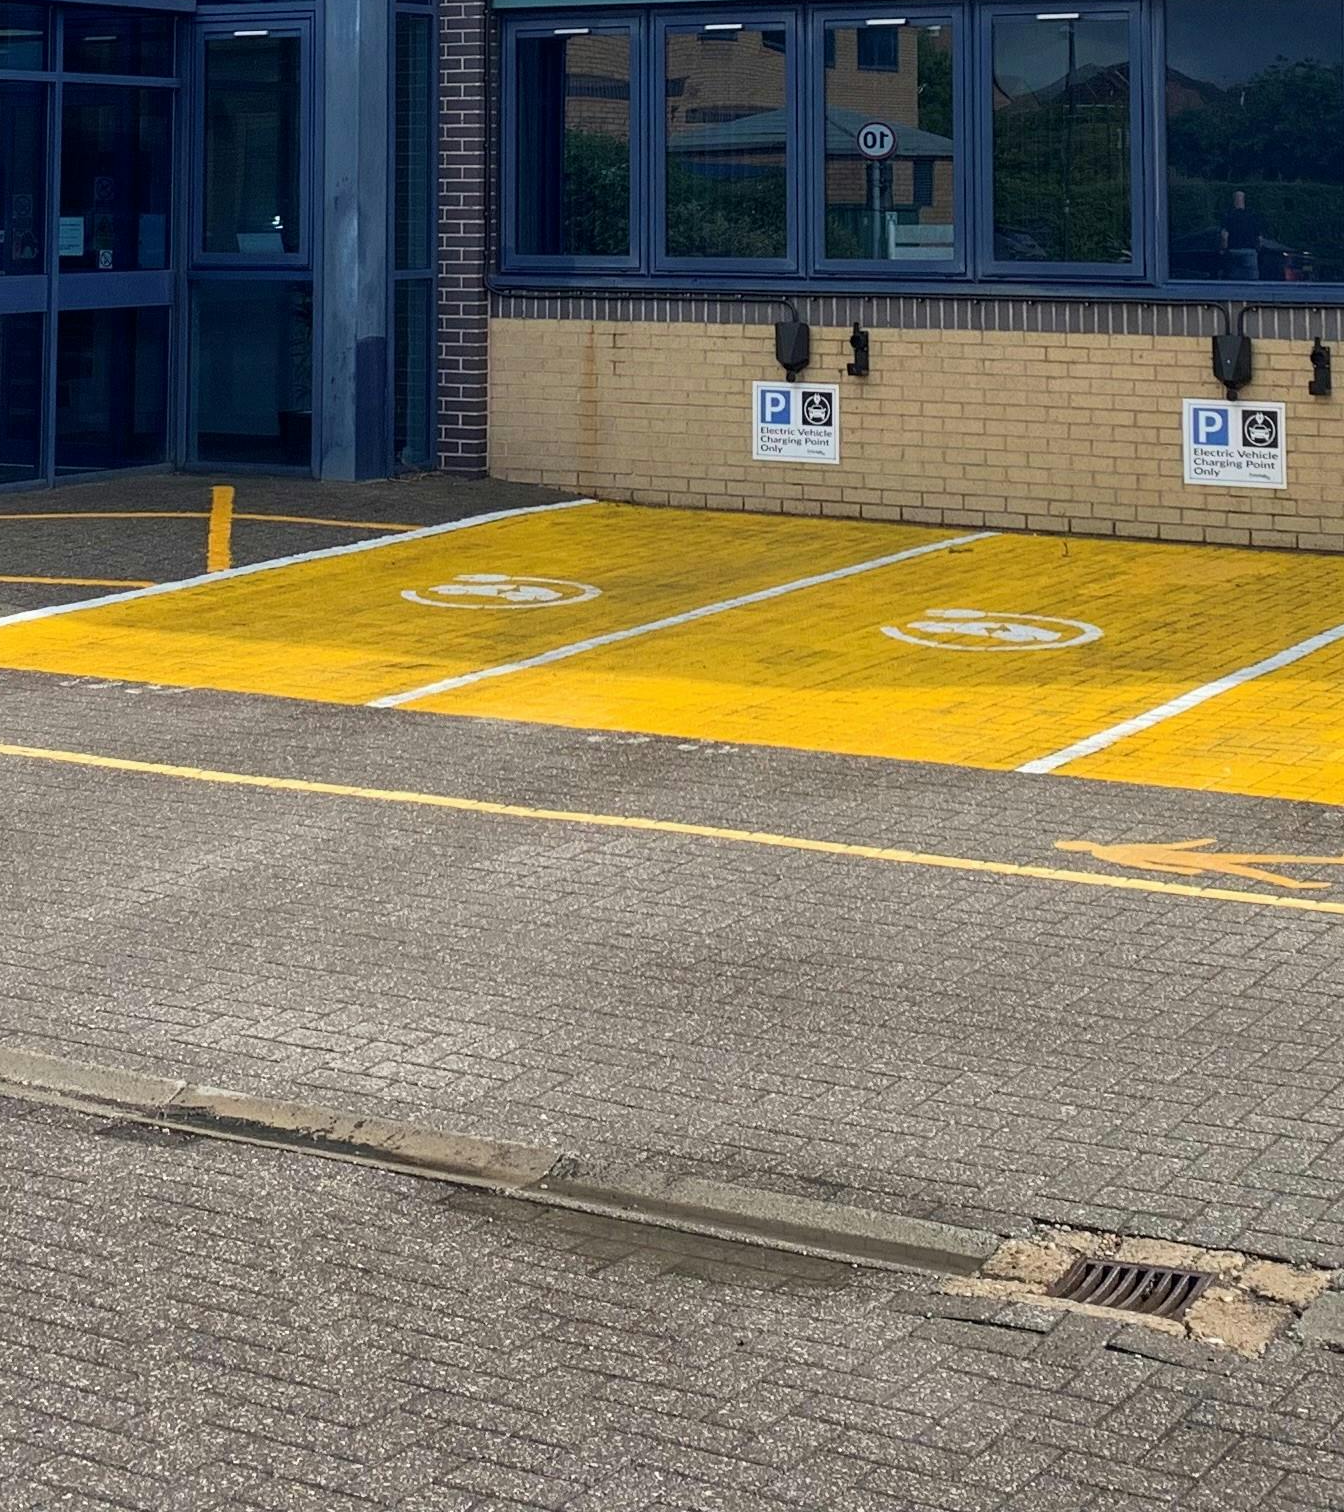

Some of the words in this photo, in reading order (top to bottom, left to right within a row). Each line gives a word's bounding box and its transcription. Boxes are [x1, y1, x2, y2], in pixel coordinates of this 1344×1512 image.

[765, 392, 786, 422] P
[760, 426, 796, 436] Electric
[798, 428, 833, 438] Vehicle
[1198, 410, 1223, 443] P
[760, 435, 802, 446] Charging
[804, 438, 830, 446] Point
[760, 444, 783, 453] Only
[1193, 448, 1235, 458] Electric
[1237, 449, 1279, 460] Vehicle
[1193, 457, 1243, 469] Charging
[1246, 460, 1276, 469] Point
[1193, 467, 1221, 477] Only
